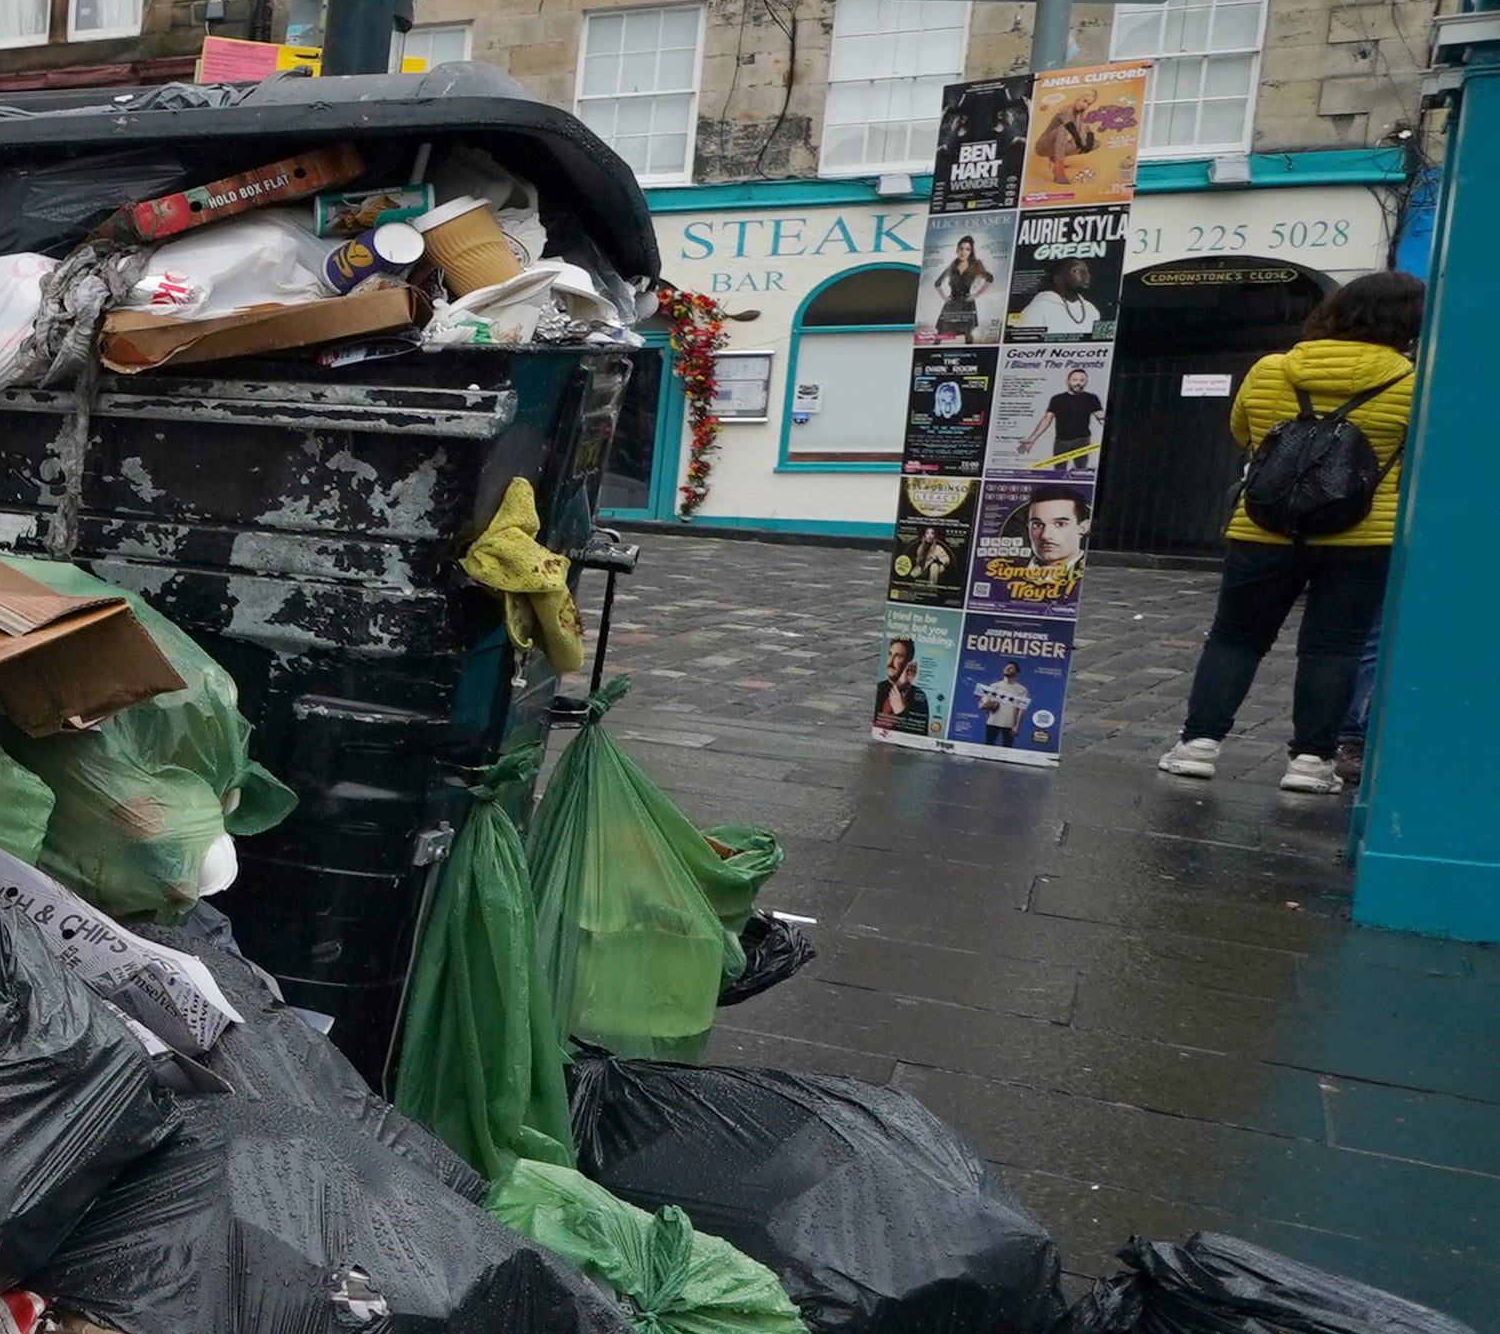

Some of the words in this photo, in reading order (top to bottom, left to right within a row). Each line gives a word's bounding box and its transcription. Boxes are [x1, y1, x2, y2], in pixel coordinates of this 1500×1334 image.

[1041, 75, 1080, 88] ANNA
[1084, 68, 1148, 84] CLIFFORD
[959, 143, 998, 164] BEN
[951, 160, 1002, 181] HART
[207, 190, 238, 210] HOLD
[238, 183, 263, 200] BOX
[263, 173, 292, 193] FLAT
[950, 177, 999, 192] WONDER
[681, 212, 921, 261] STEAK
[1018, 216, 1069, 245] AURIE
[1071, 213, 1129, 242] STYLA
[1186, 224, 1248, 253] 225
[1268, 219, 1350, 249] 5028
[1034, 242, 1107, 261] GREEN
[710, 270, 787, 294] BAR
[1150, 271, 1242, 282] EDMONSTONE'S
[1250, 270, 1289, 280] CLOSE
[1007, 348, 1047, 359] Geoff
[1050, 347, 1109, 358] Norcott
[1010, 360, 1042, 369] Blame
[1044, 359, 1063, 369] The
[1065, 359, 1105, 369] Parents
[986, 559, 1068, 579] Sigmund
[892, 611, 912, 621] tried
[913, 613, 922, 622] to
[925, 614, 938, 625] be
[912, 623, 928, 634] but
[929, 627, 948, 637] you
[1014, 630, 1049, 641] PARSONS
[966, 634, 1066, 659] EQUALISER
[35, 900, 56, 925] &
[59, 912, 130, 954] CHIPS
